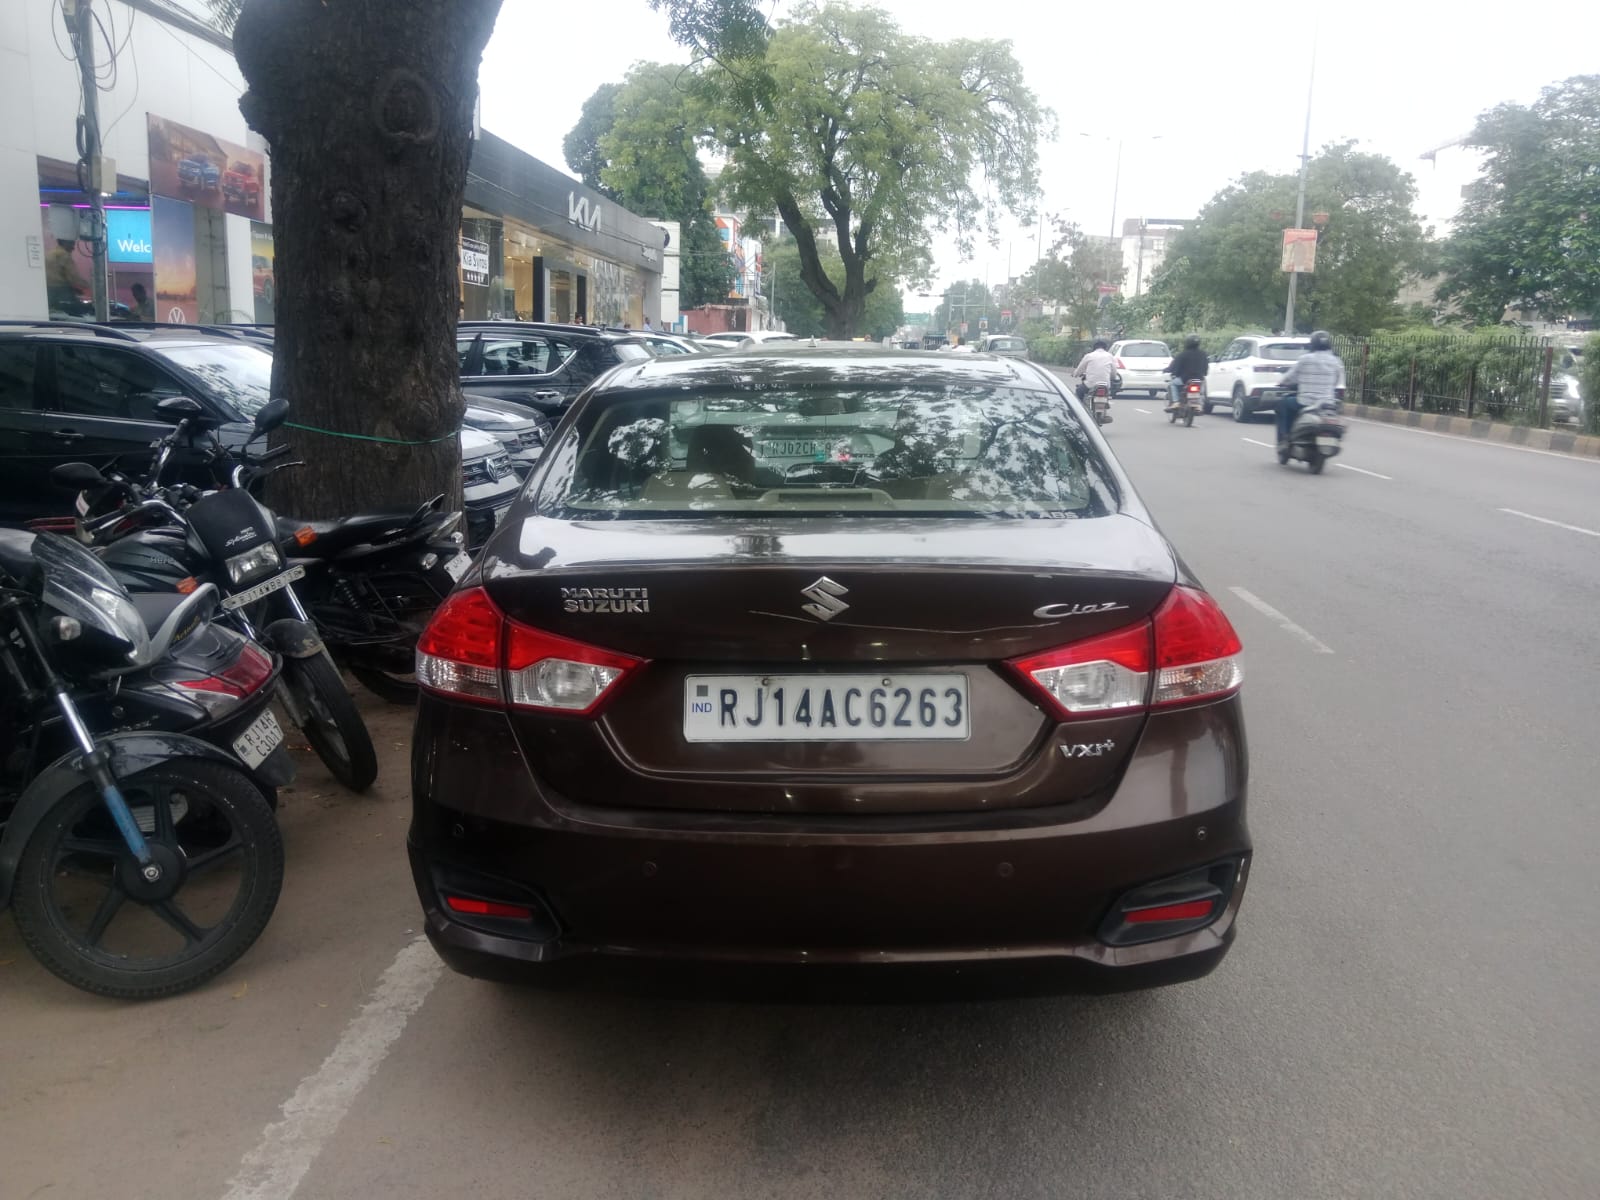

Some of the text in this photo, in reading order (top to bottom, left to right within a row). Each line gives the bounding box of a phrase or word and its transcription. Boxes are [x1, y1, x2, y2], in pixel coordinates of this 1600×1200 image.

[1040, 511, 1079, 519] ABS
[560, 587, 648, 599] MARUTI
[563, 599, 650, 613] SUZUKI
[1033, 602, 1130, 619] Ciaz
[692, 687, 963, 728] IND RJ14AC6263
